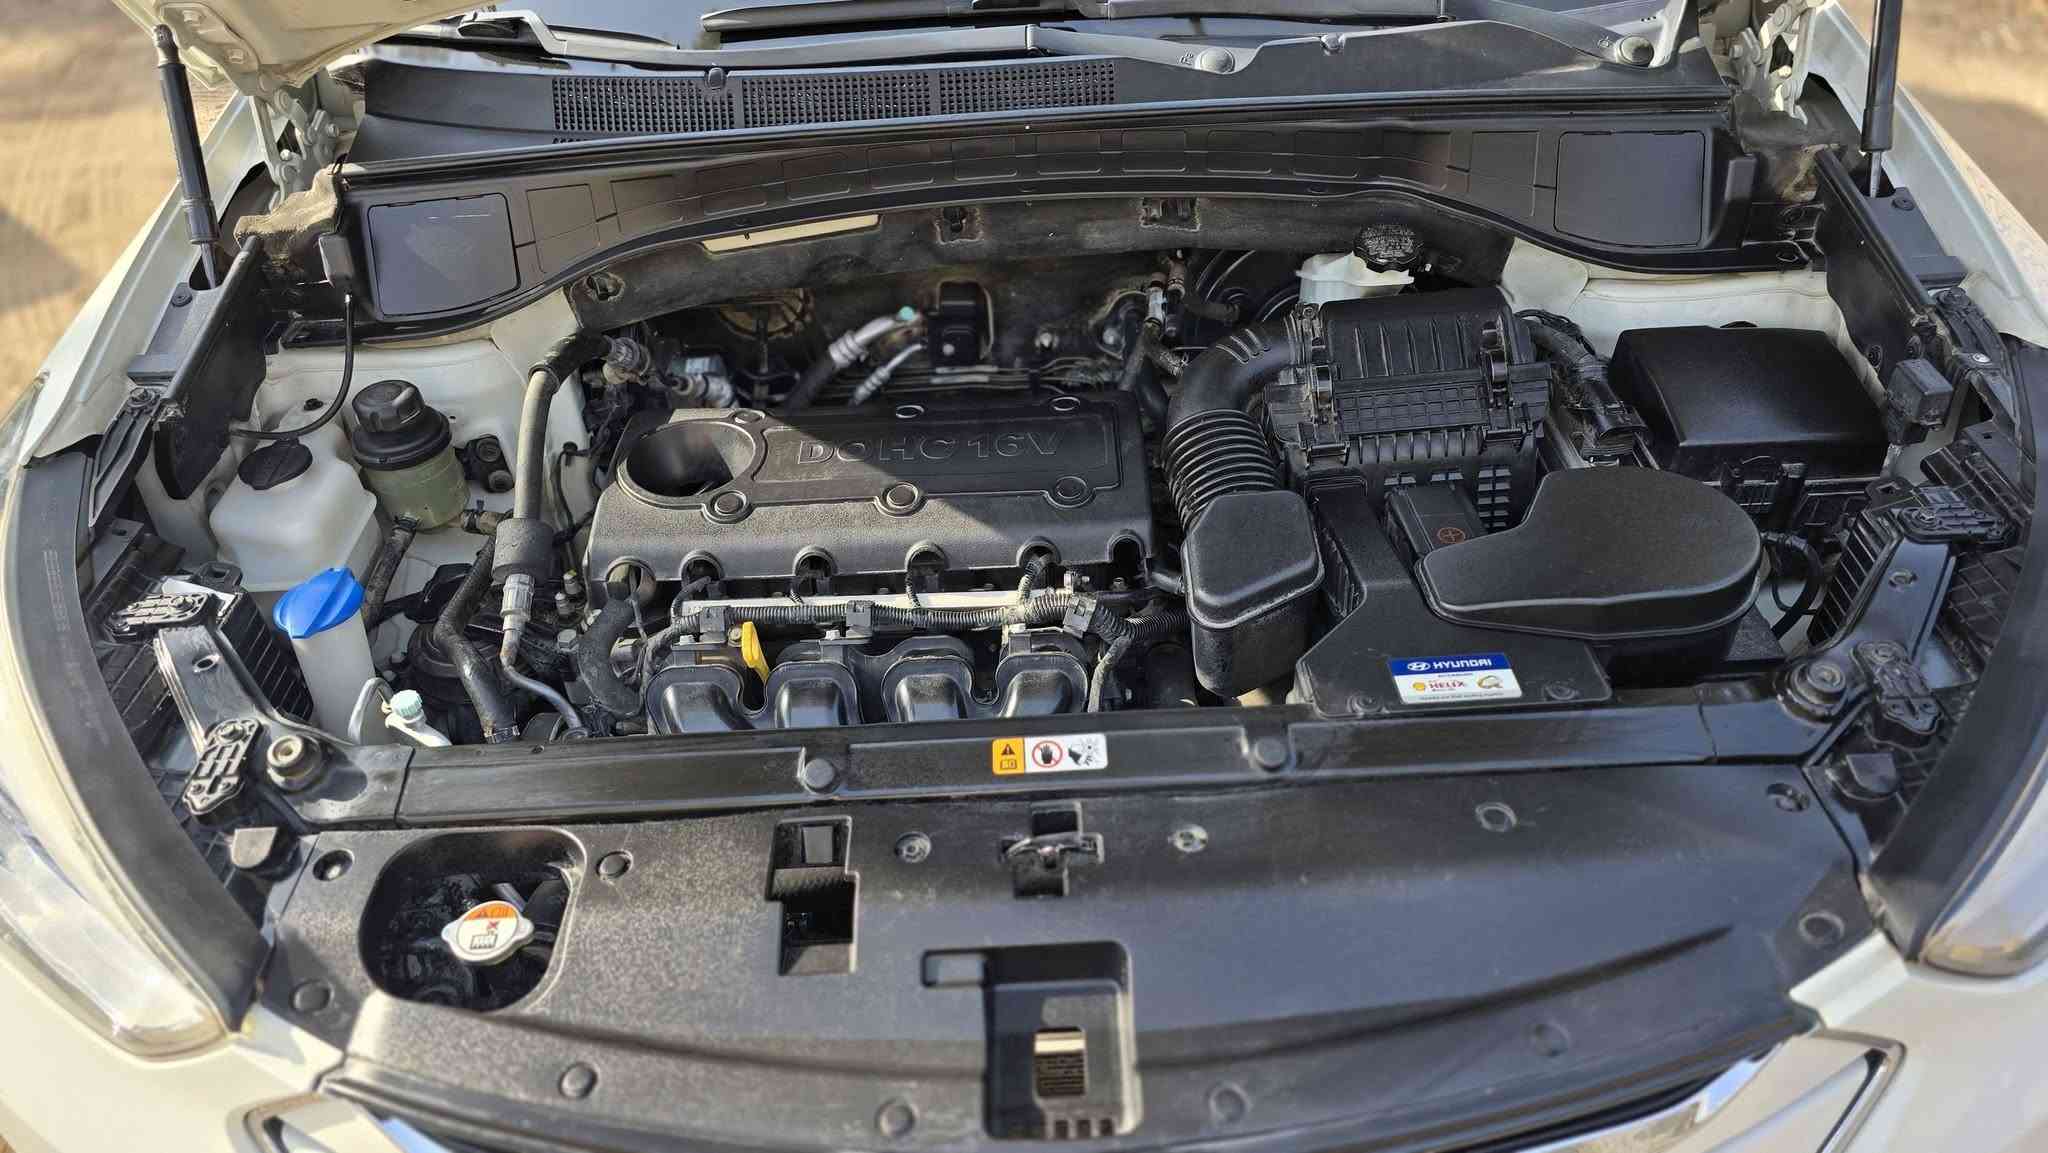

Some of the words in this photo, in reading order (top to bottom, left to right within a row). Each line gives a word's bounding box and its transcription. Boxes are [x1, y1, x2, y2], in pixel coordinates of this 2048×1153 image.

[797, 438, 957, 465] DOHC
[966, 431, 1063, 458] 16V
[1432, 658, 1492, 670] HYUNDAI
[1429, 680, 1465, 689] HELIX
